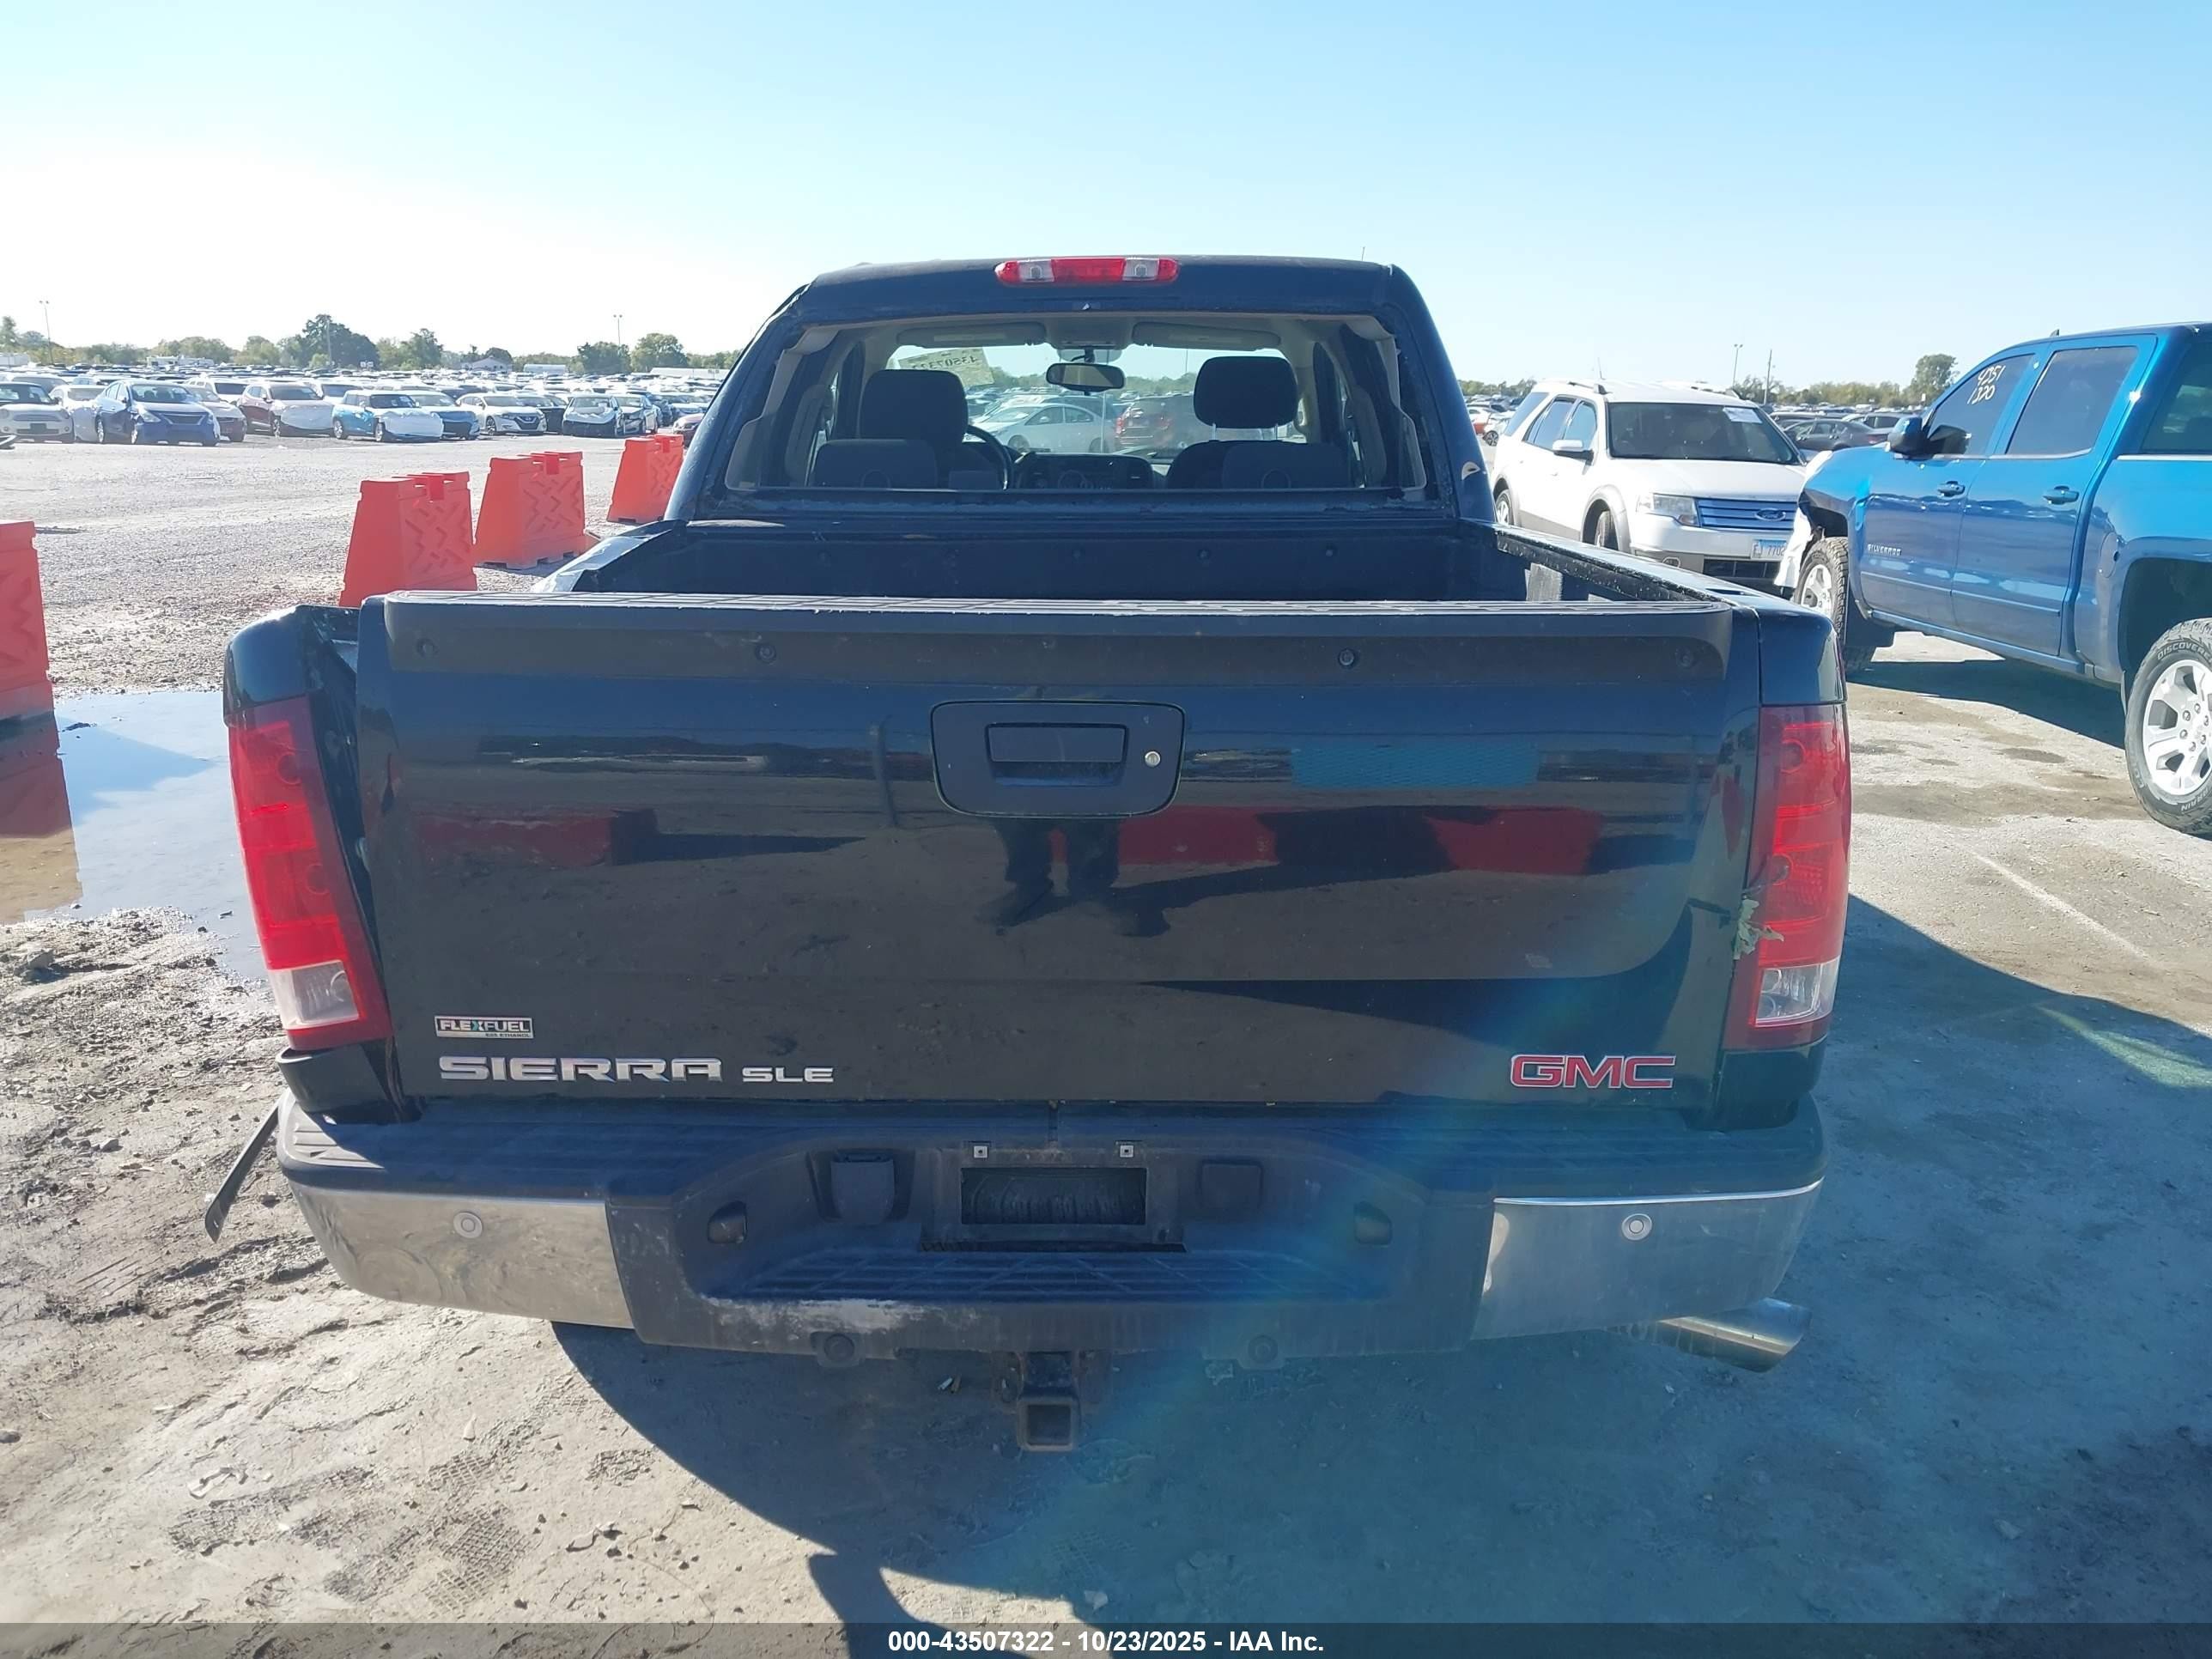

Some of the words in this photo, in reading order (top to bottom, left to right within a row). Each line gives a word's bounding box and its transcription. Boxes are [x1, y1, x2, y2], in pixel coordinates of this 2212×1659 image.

[440, 1019, 530, 1032] FLEXFUEL
[439, 1056, 722, 1083] SIERRA
[742, 1066, 834, 1083] SLE
[1510, 1054, 1676, 1089] GMC
